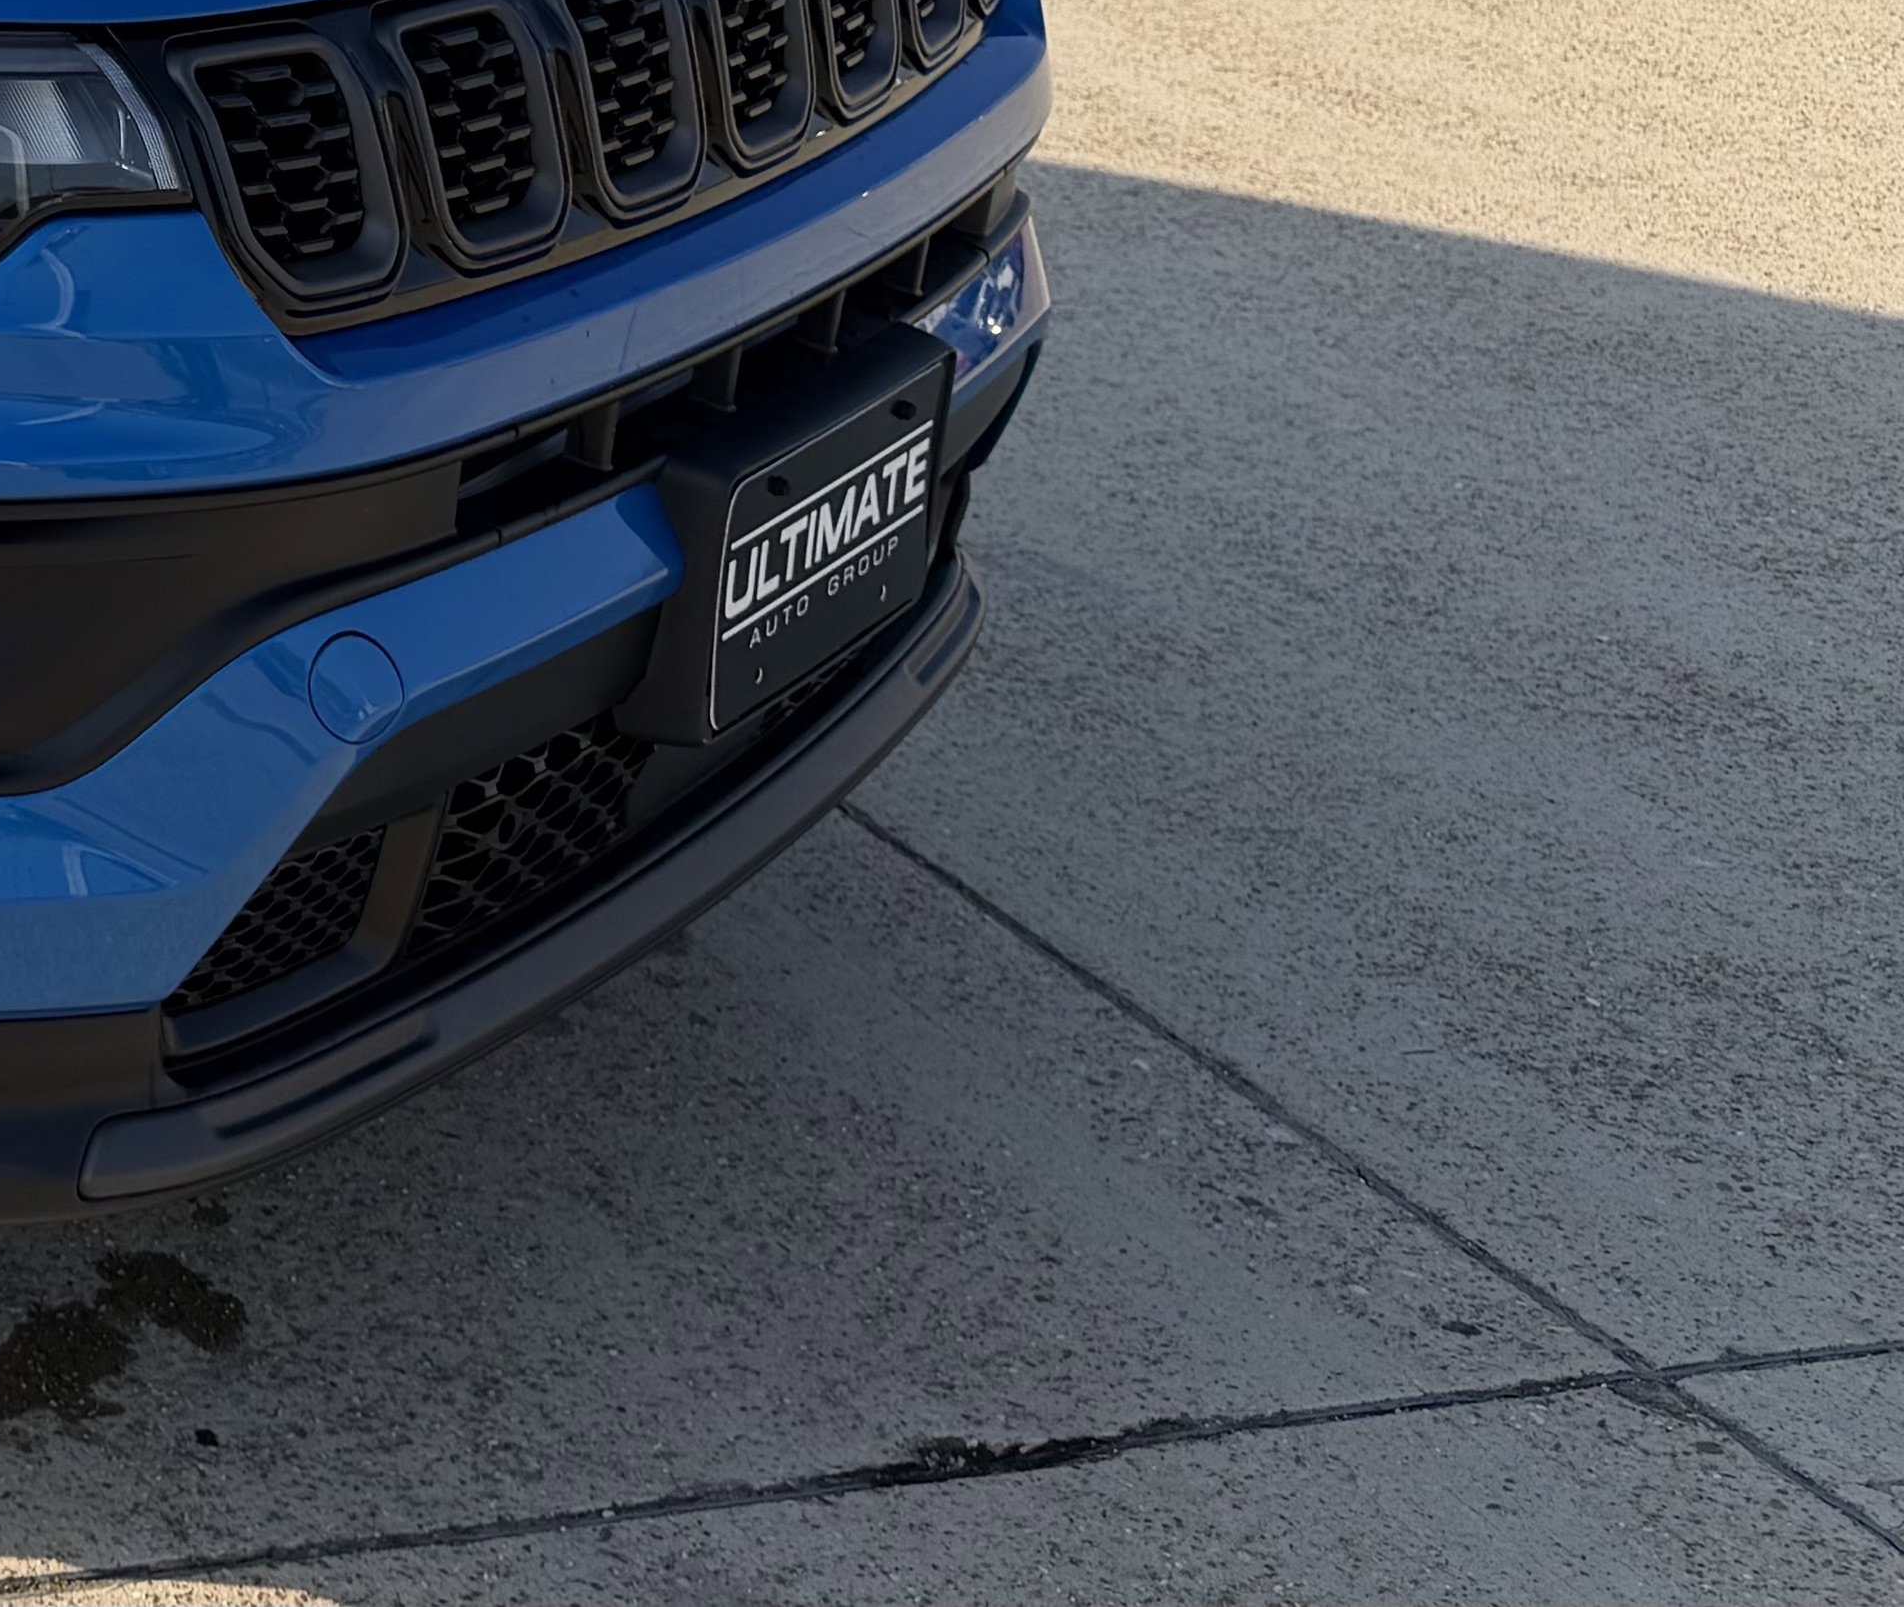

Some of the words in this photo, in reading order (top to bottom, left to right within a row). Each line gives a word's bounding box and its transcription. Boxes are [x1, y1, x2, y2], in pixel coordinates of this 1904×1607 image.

[724, 436, 931, 620] ULTIMATE
[749, 597, 810, 650] AUTO
[827, 536, 900, 597] GROUP
